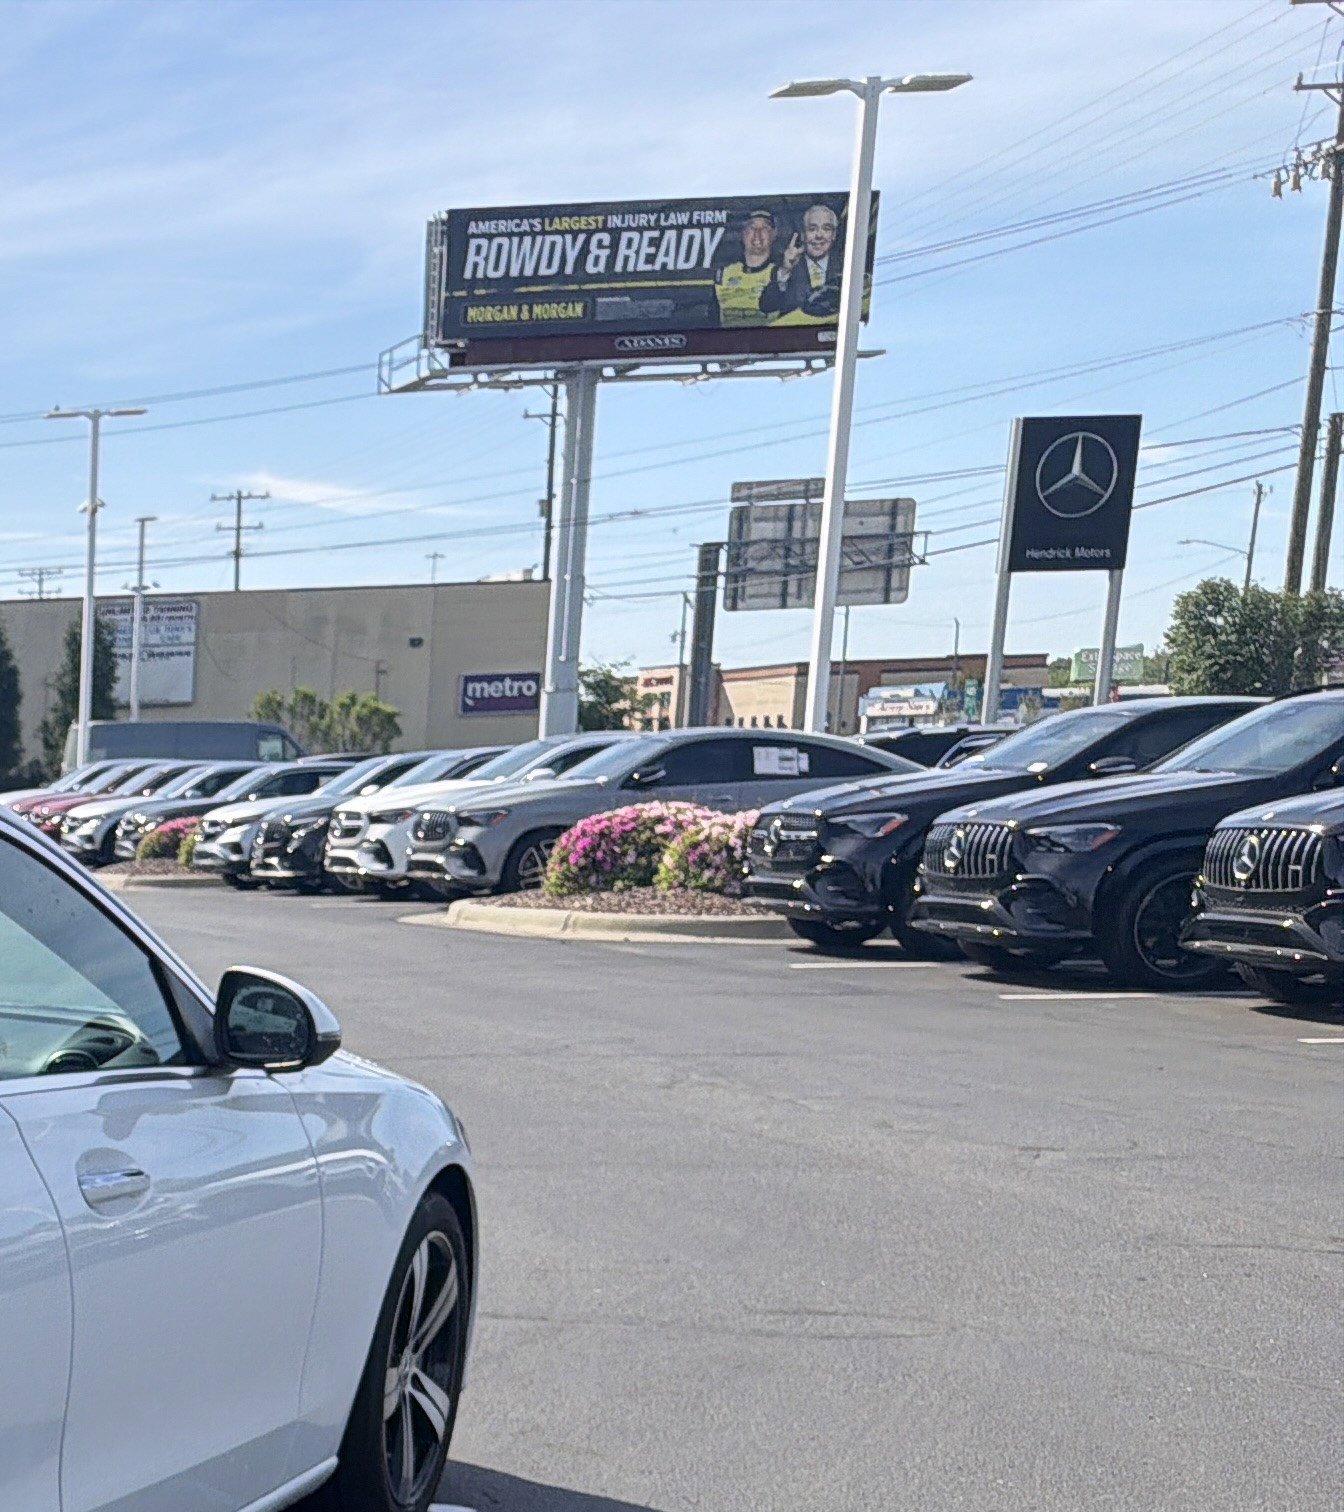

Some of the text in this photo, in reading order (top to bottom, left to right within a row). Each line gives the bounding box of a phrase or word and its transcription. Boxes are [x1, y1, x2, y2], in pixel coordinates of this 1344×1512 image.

[467, 210, 727, 235] AMERICA'S LARGEST INJURY LAW FIRM
[463, 227, 725, 279] ROWDY & READY
[467, 305, 518, 323] MORGAN
[520, 304, 530, 321] &
[532, 302, 584, 319] MORGAN
[1026, 547, 1111, 559] Hendrick Motors
[467, 677, 537, 698] metro
